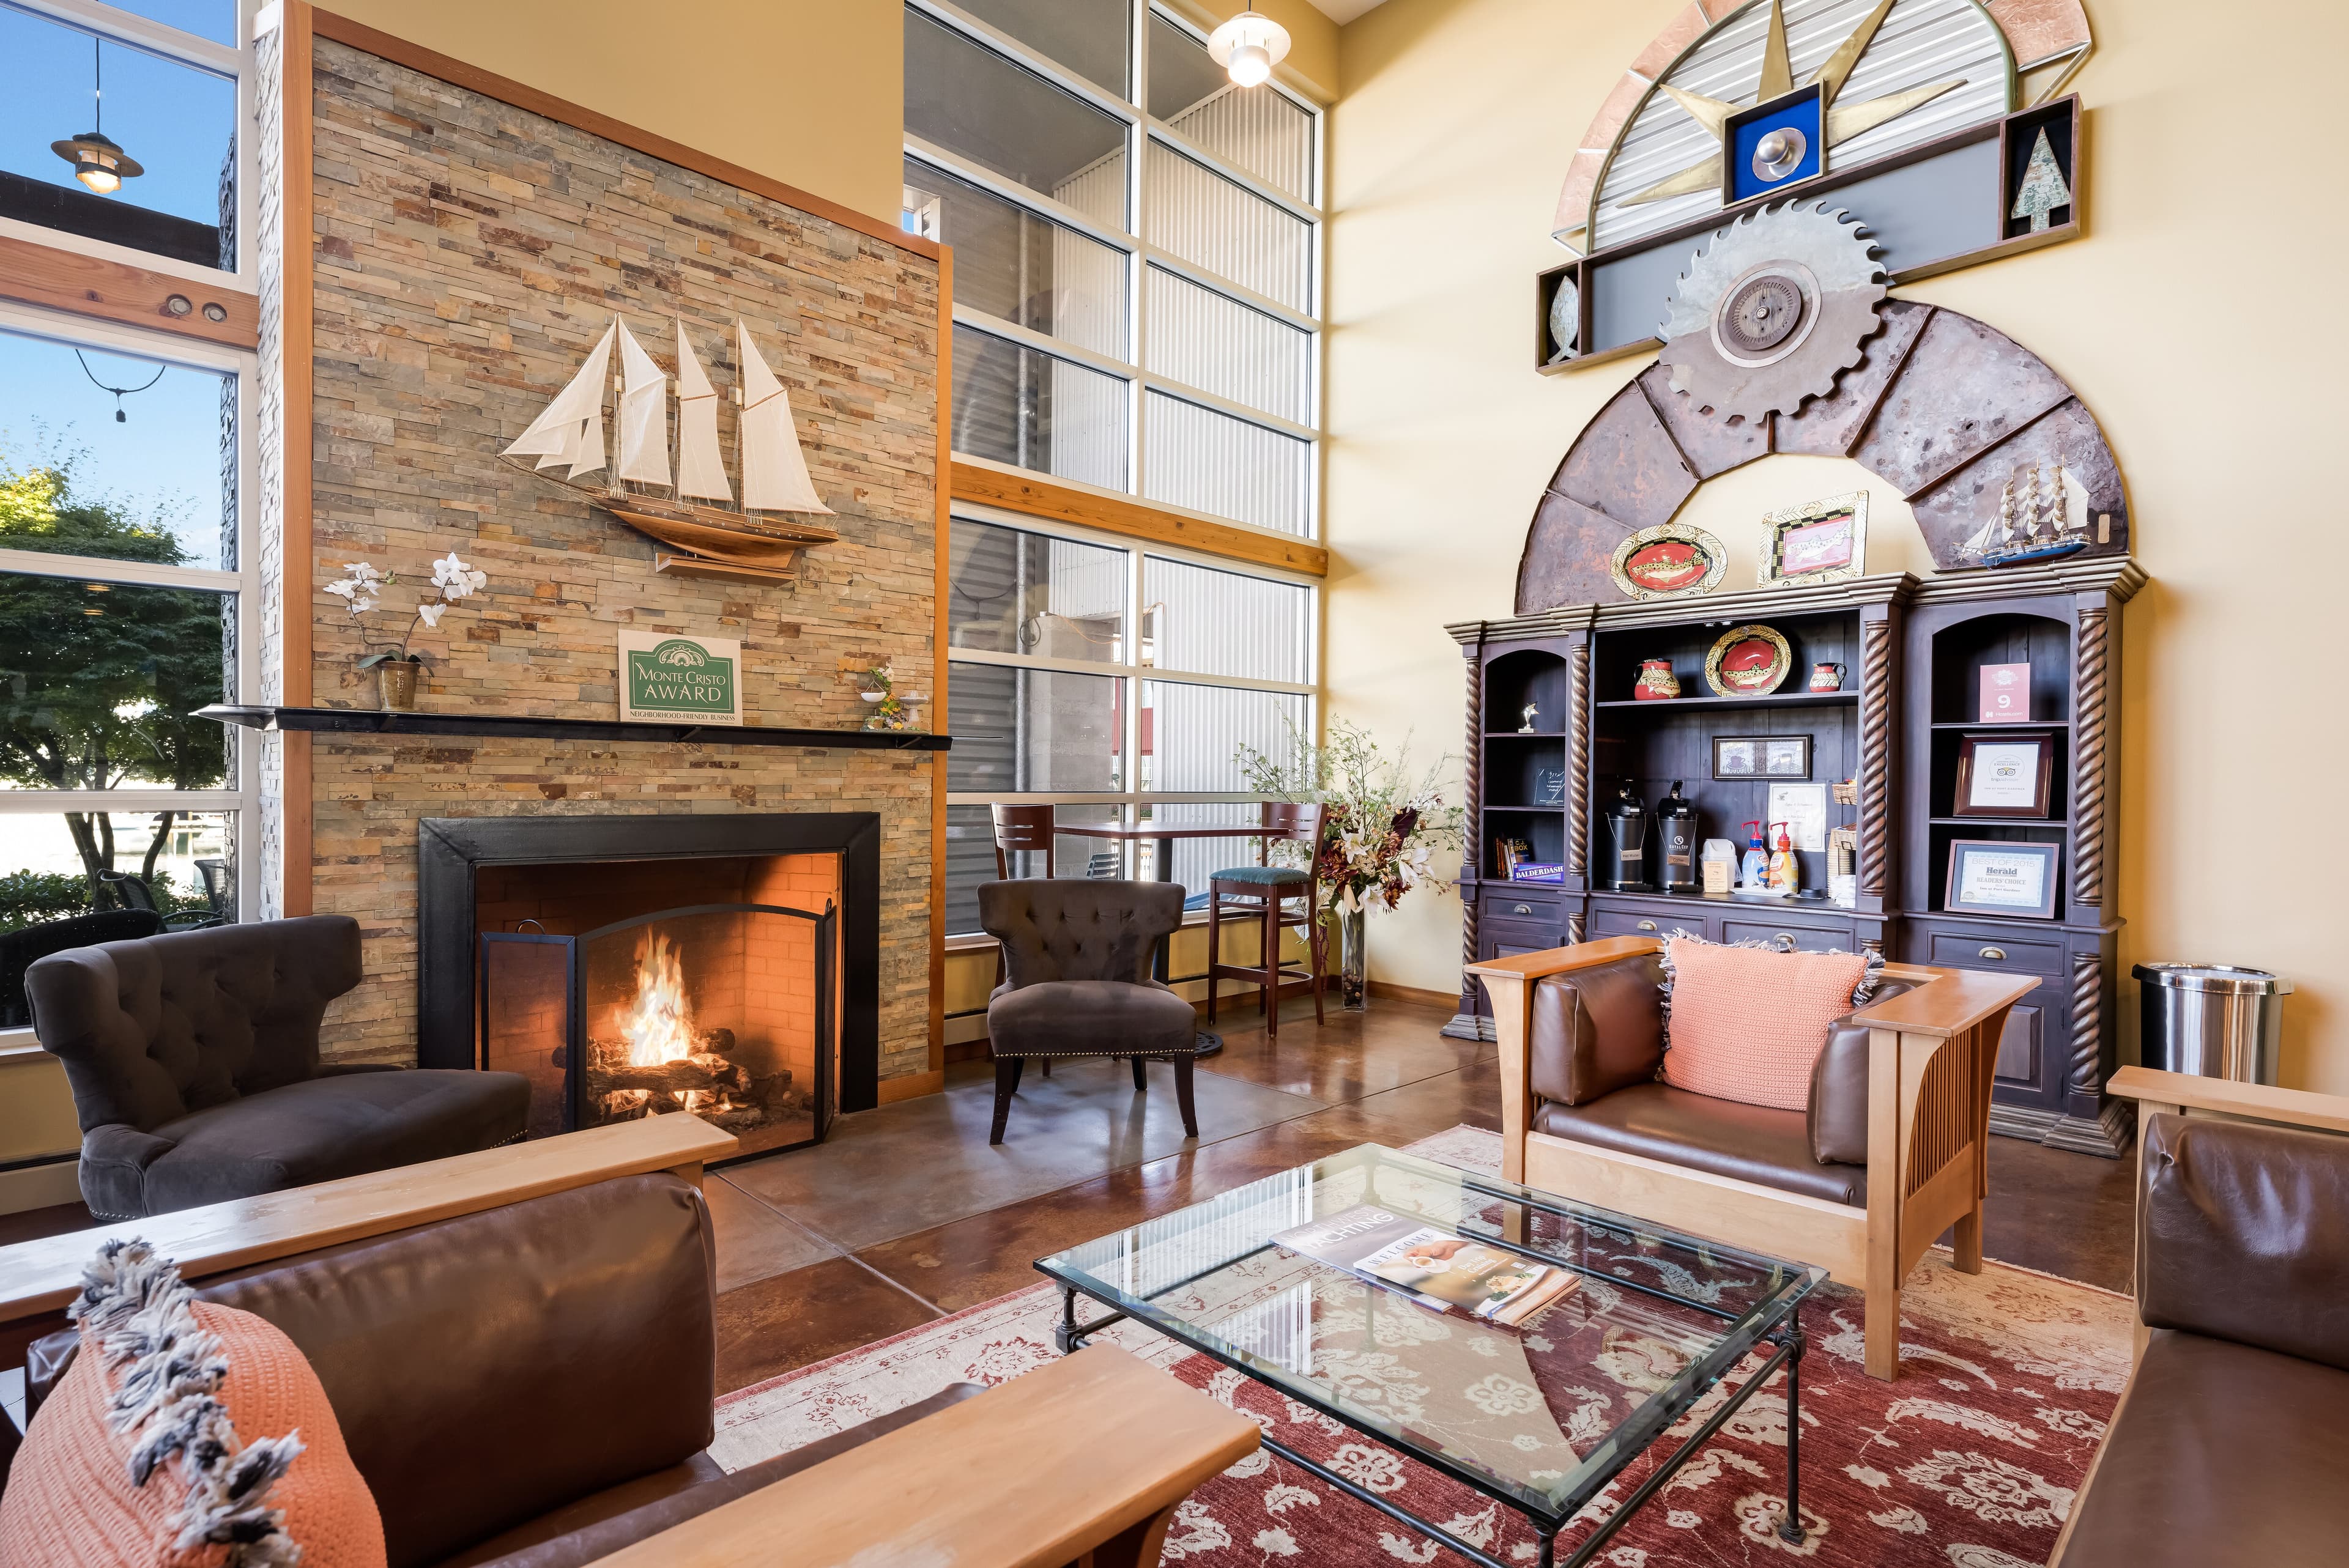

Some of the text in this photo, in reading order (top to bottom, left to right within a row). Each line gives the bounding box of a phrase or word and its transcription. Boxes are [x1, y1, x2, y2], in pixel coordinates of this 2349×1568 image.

[635, 662, 726, 686] MONTE CRISTO
[644, 684, 722, 704] AWARD
[1997, 695, 2011, 709] 9
[630, 710, 708, 720] NEIGHBORHOOD-FRIENDLY
[1516, 865, 1564, 879] BALDERDASH
[1986, 867, 2017, 875] Herald
[1303, 1213, 1395, 1249] YACHTING
[1368, 1231, 1433, 1266] WELCOME
